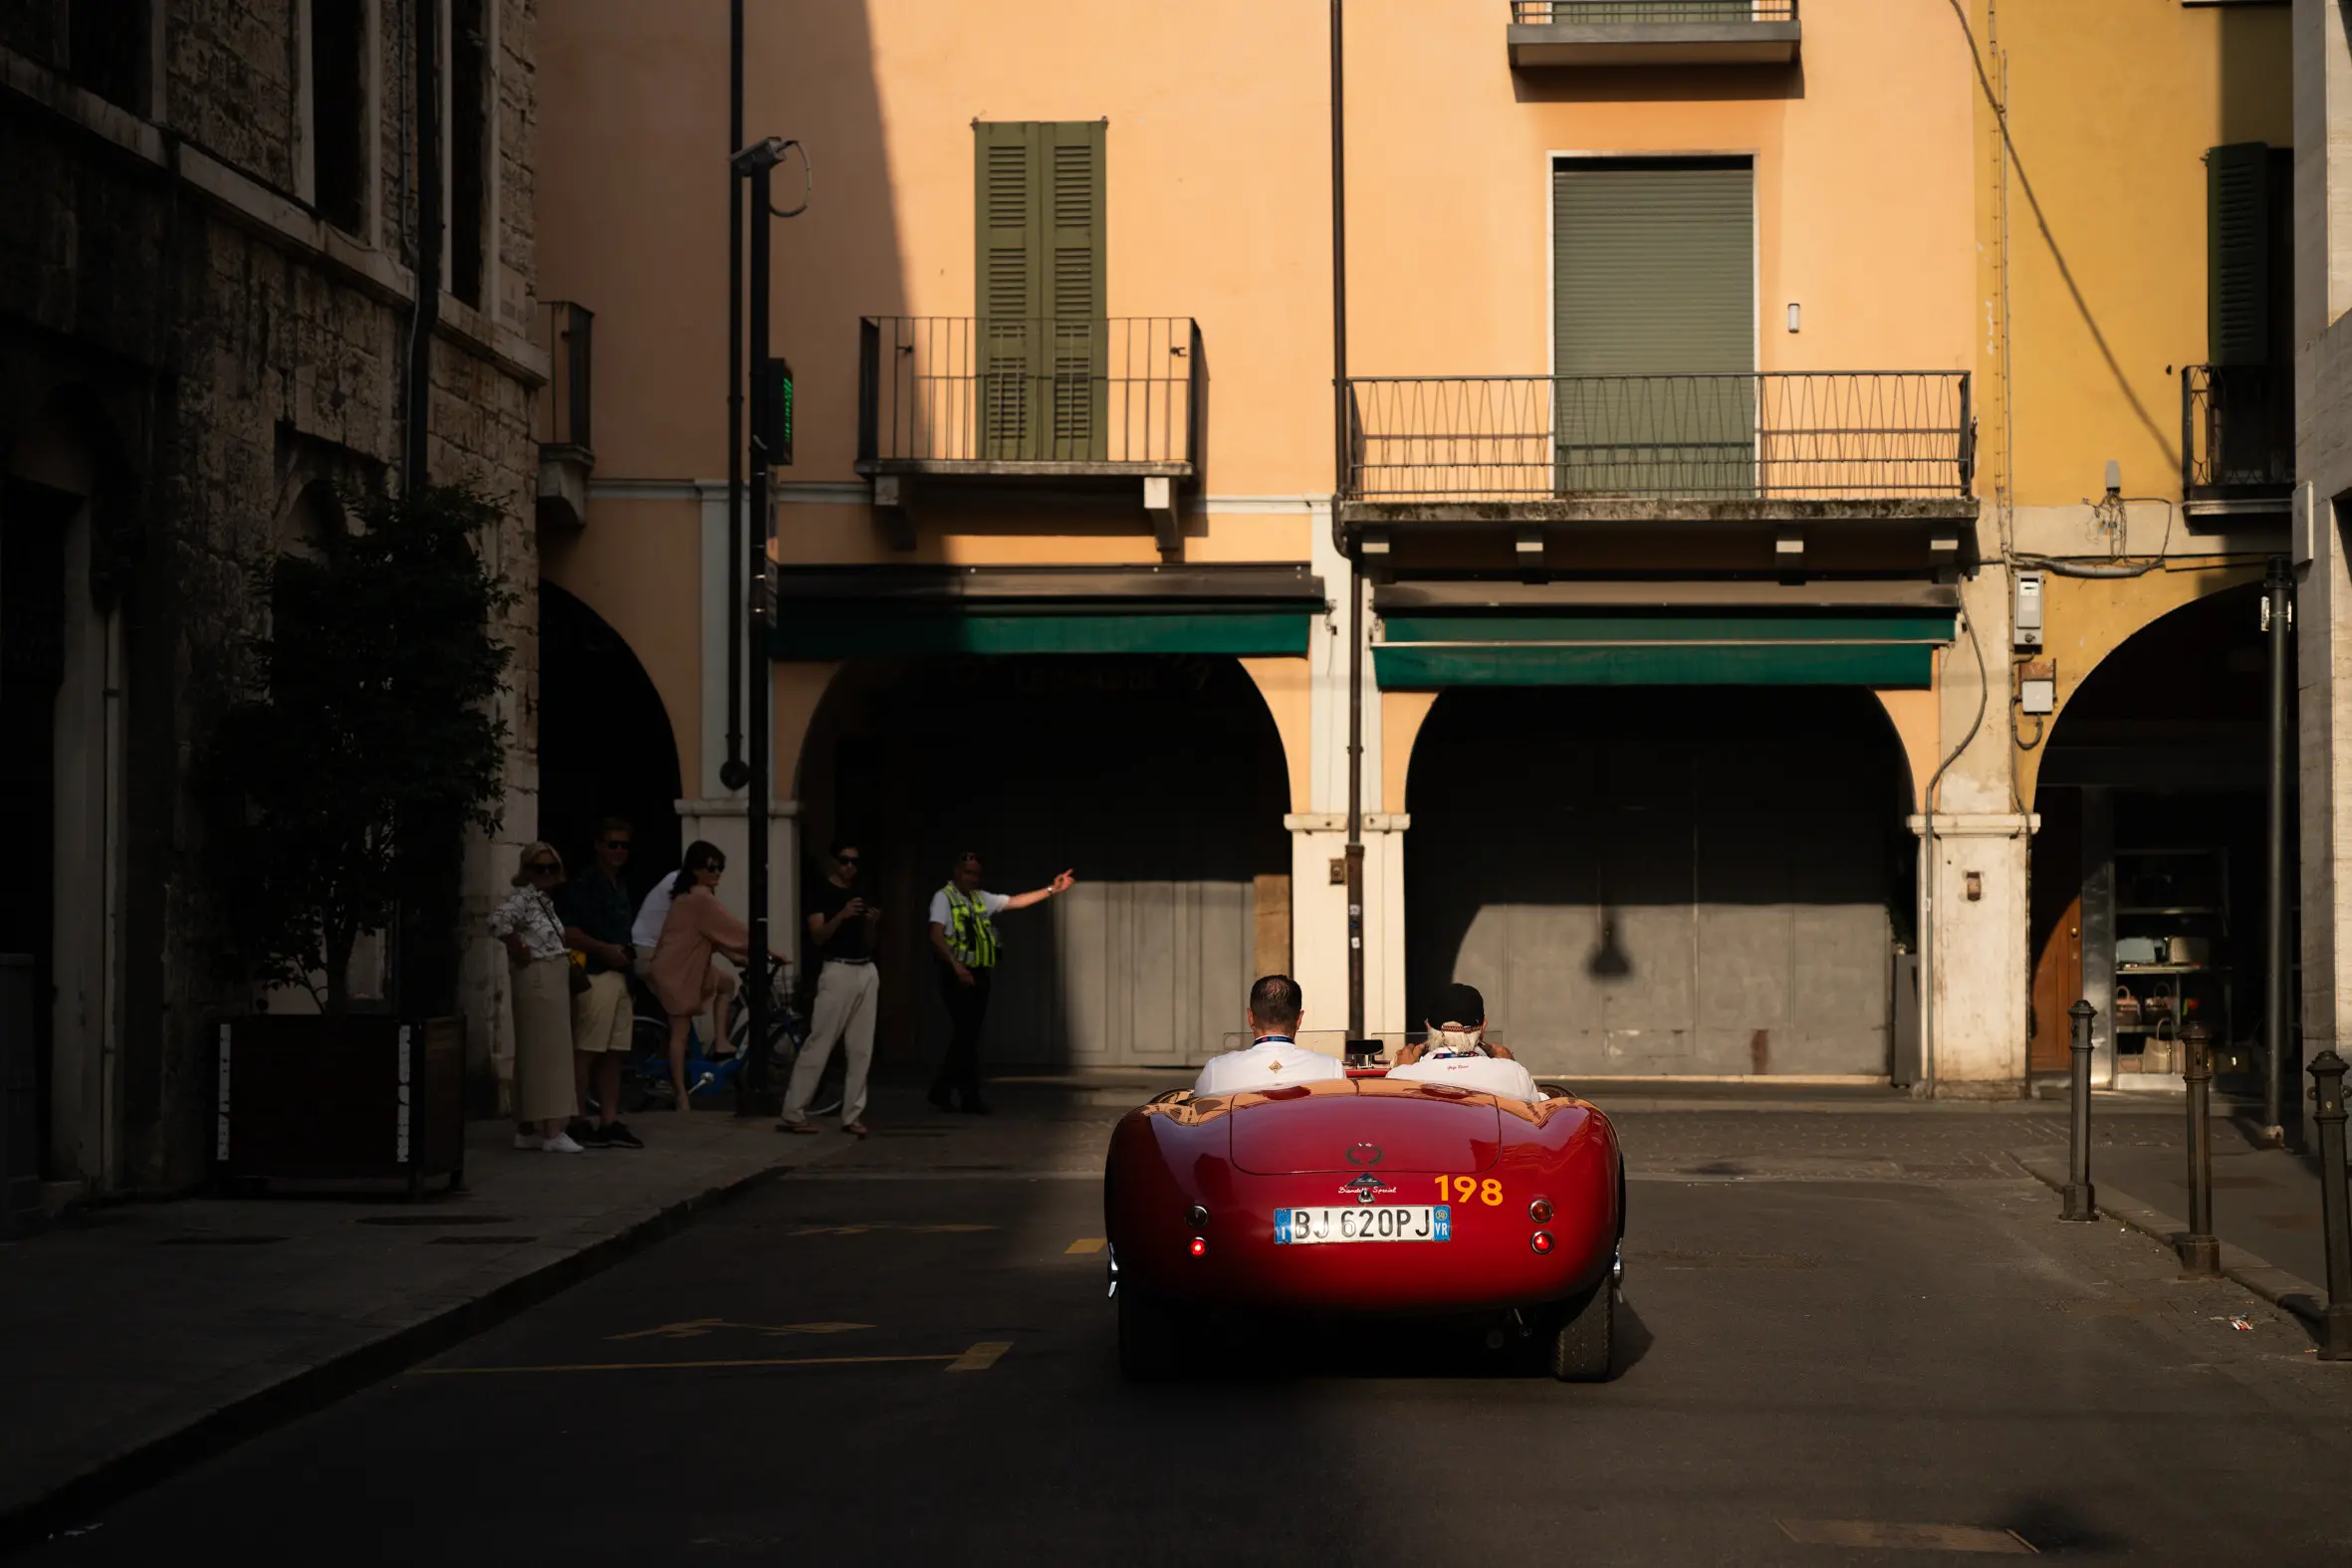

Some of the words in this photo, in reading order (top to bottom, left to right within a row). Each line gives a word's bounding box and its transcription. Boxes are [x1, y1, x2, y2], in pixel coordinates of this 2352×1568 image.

[1372, 1186, 1397, 1195] Special
[1435, 1175, 1503, 1206] 198
[1435, 1222, 1448, 1236] VR
